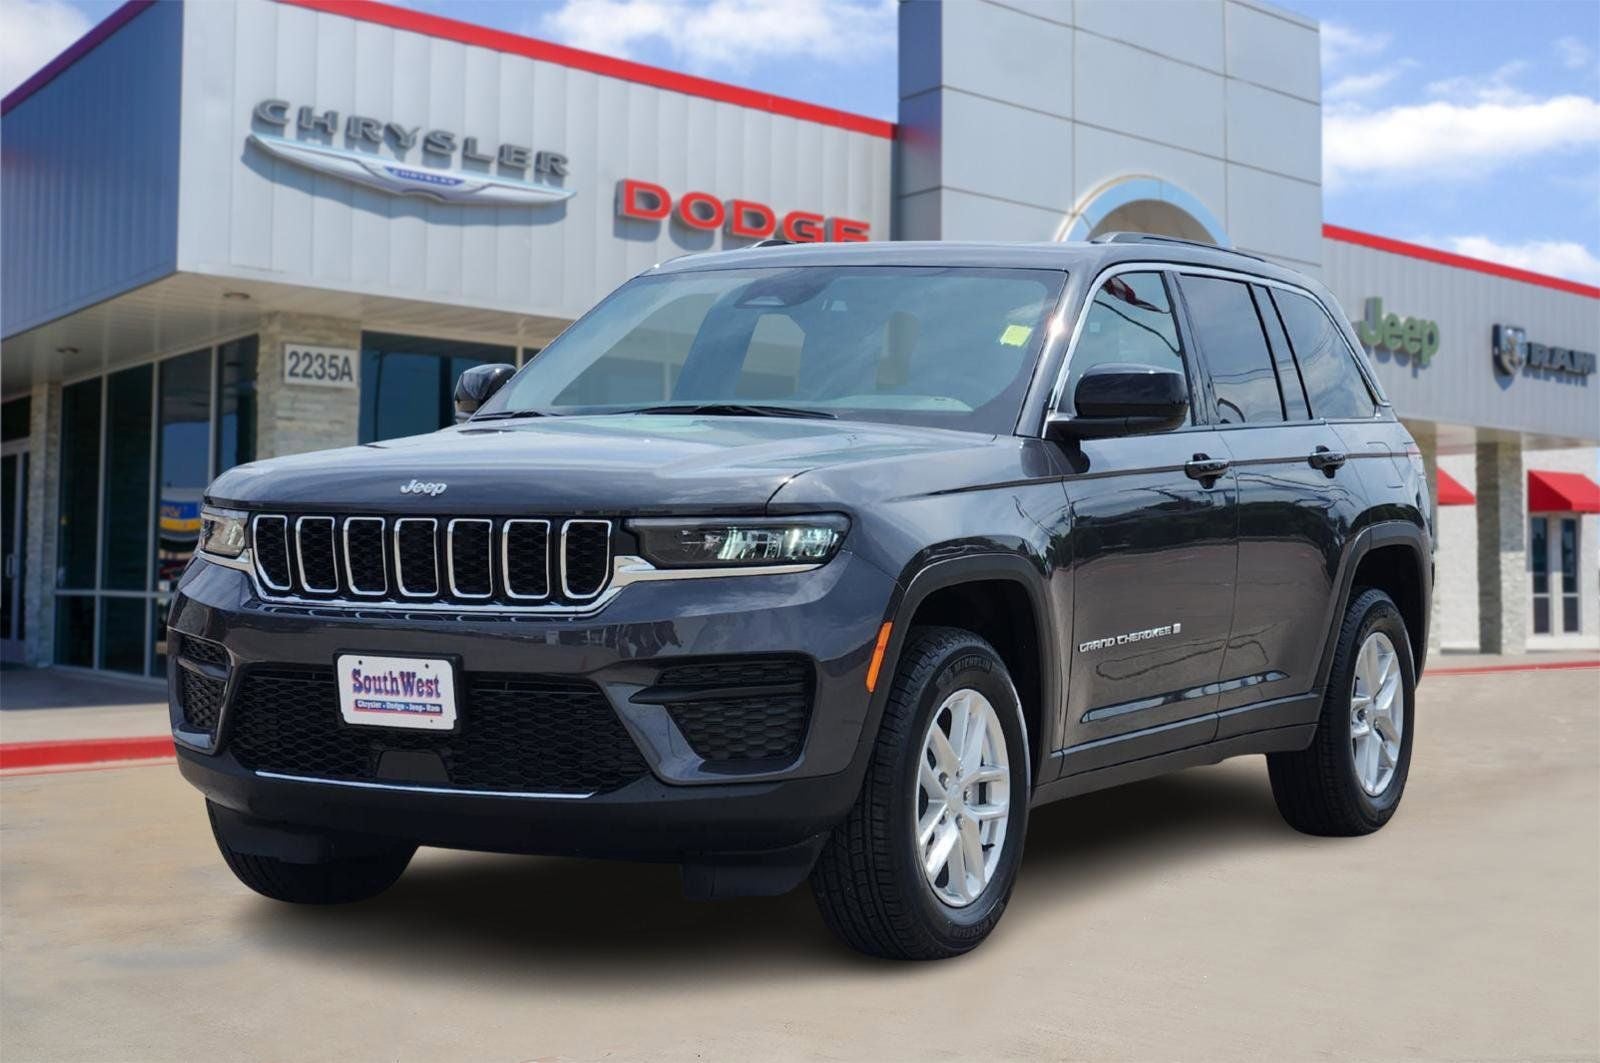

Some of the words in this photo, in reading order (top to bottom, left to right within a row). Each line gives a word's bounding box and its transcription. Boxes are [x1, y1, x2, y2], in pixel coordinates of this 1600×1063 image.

[252, 99, 569, 176] CHRYSLER
[616, 178, 871, 243] DODGE
[1360, 297, 1439, 365] Jeep
[288, 351, 354, 383] 2235A
[1526, 342, 1597, 375] RAM
[400, 479, 448, 497] Jeep
[1079, 638, 1116, 653] GRAND
[1117, 625, 1172, 645] CHEROKEE
[351, 668, 442, 699] SouthWest
